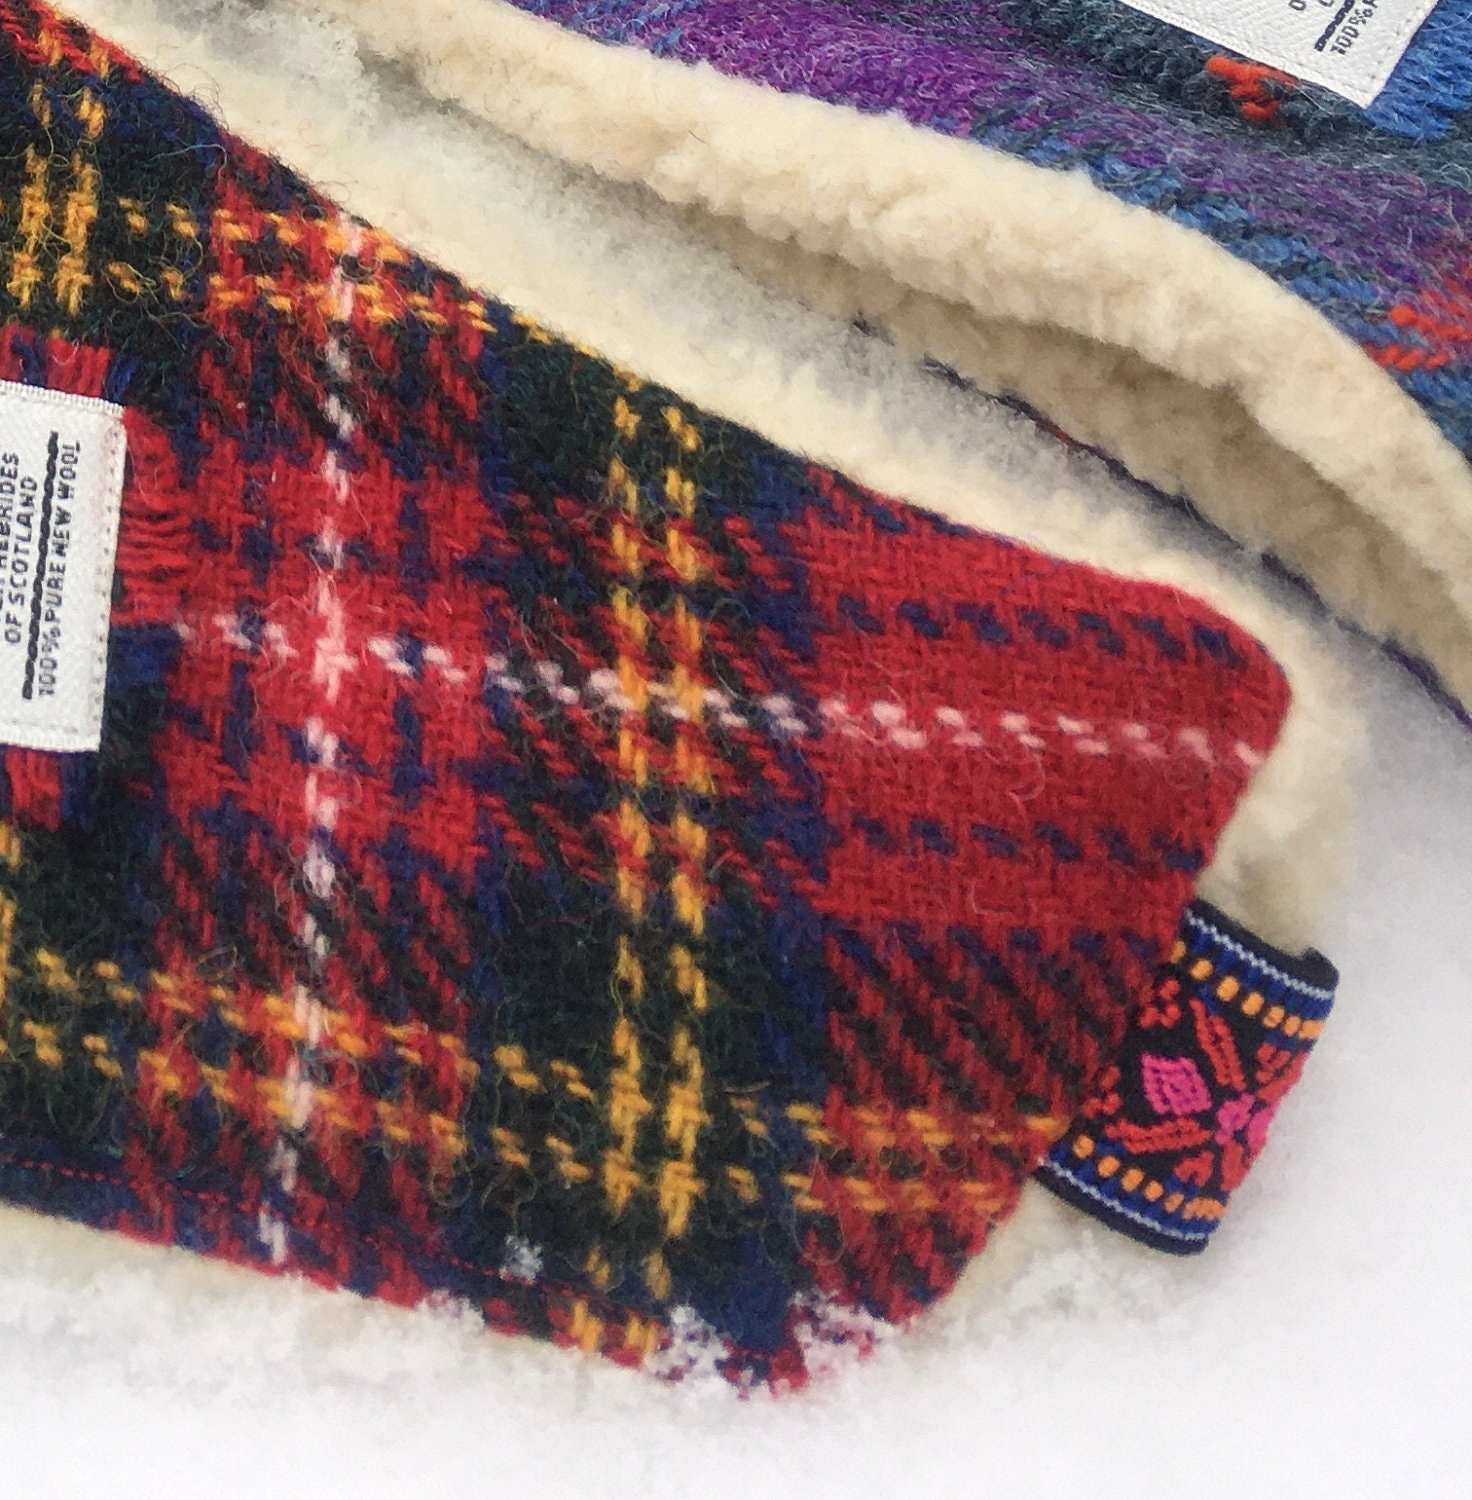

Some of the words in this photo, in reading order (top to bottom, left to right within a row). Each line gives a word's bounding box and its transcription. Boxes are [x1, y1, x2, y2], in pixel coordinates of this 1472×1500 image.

[57, 440, 81, 500] WOOL
[8, 476, 38, 606] SCOTLAND
[52, 505, 72, 557] NEW
[4, 611, 23, 643] OF
